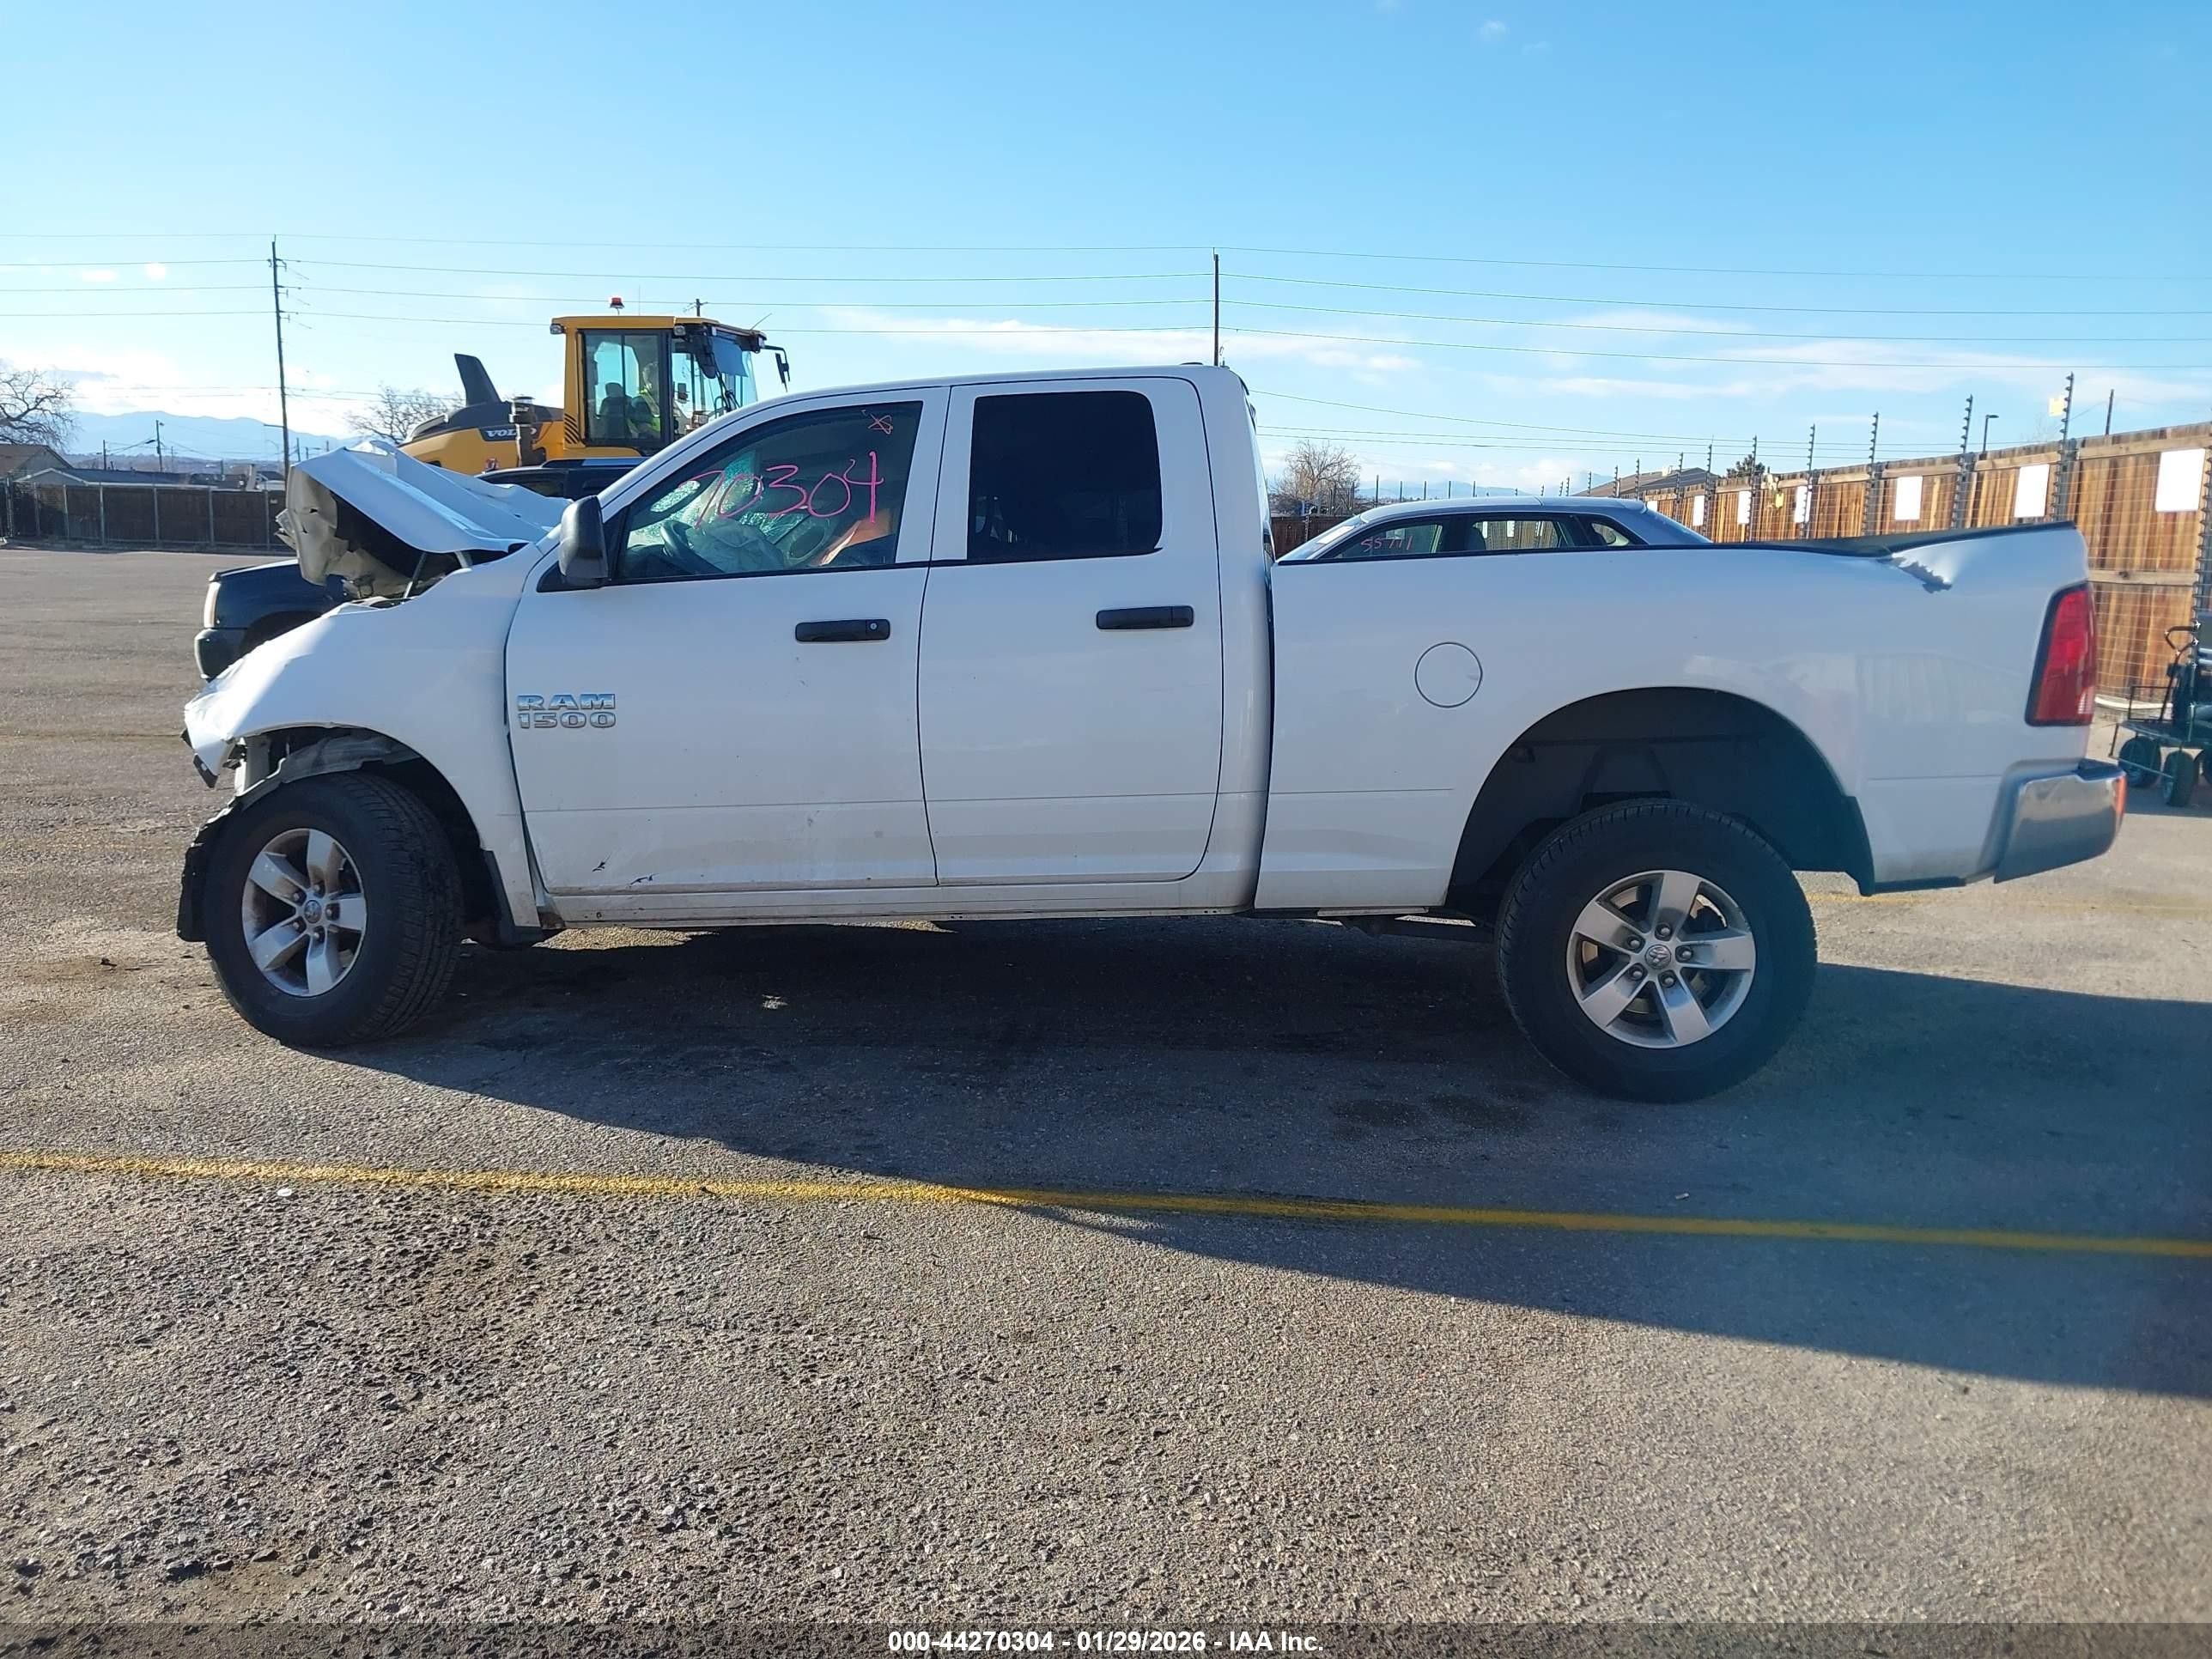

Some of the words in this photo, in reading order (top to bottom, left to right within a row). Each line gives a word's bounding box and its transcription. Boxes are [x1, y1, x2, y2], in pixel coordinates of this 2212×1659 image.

[486, 428, 538, 437] VOLO
[678, 451, 884, 529] 70304
[517, 693, 616, 711] RAM
[518, 711, 617, 729] 1500
